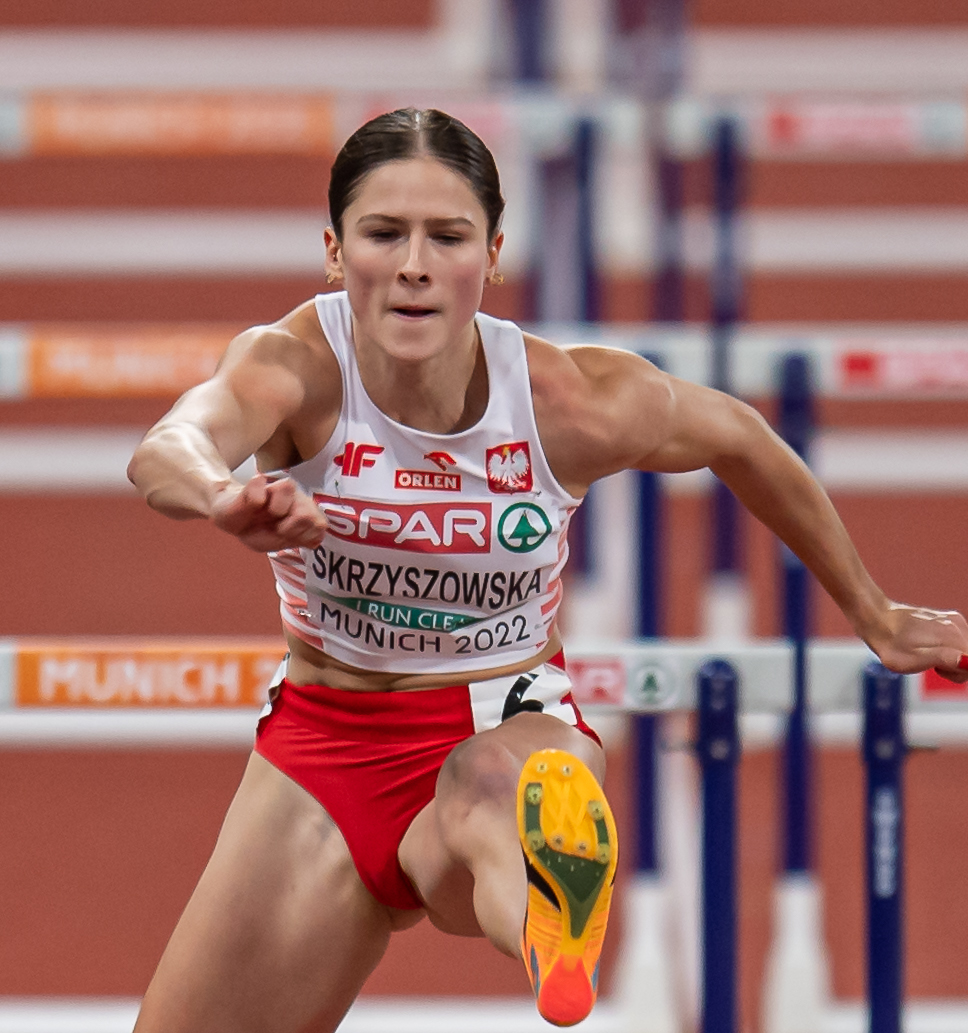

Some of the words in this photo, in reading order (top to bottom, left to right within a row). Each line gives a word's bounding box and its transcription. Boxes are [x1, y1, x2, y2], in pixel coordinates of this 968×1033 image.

[398, 473, 457, 489] ORLEN
[318, 502, 485, 547] SPAR
[312, 546, 541, 610] SKRZYSZOWSKA
[320, 602, 440, 653] MUNICH
[455, 615, 530, 654] 2022
[368, 602, 411, 627] RUN
[417, 612, 466, 632] CLE
[39, 658, 239, 702] MUNICH
